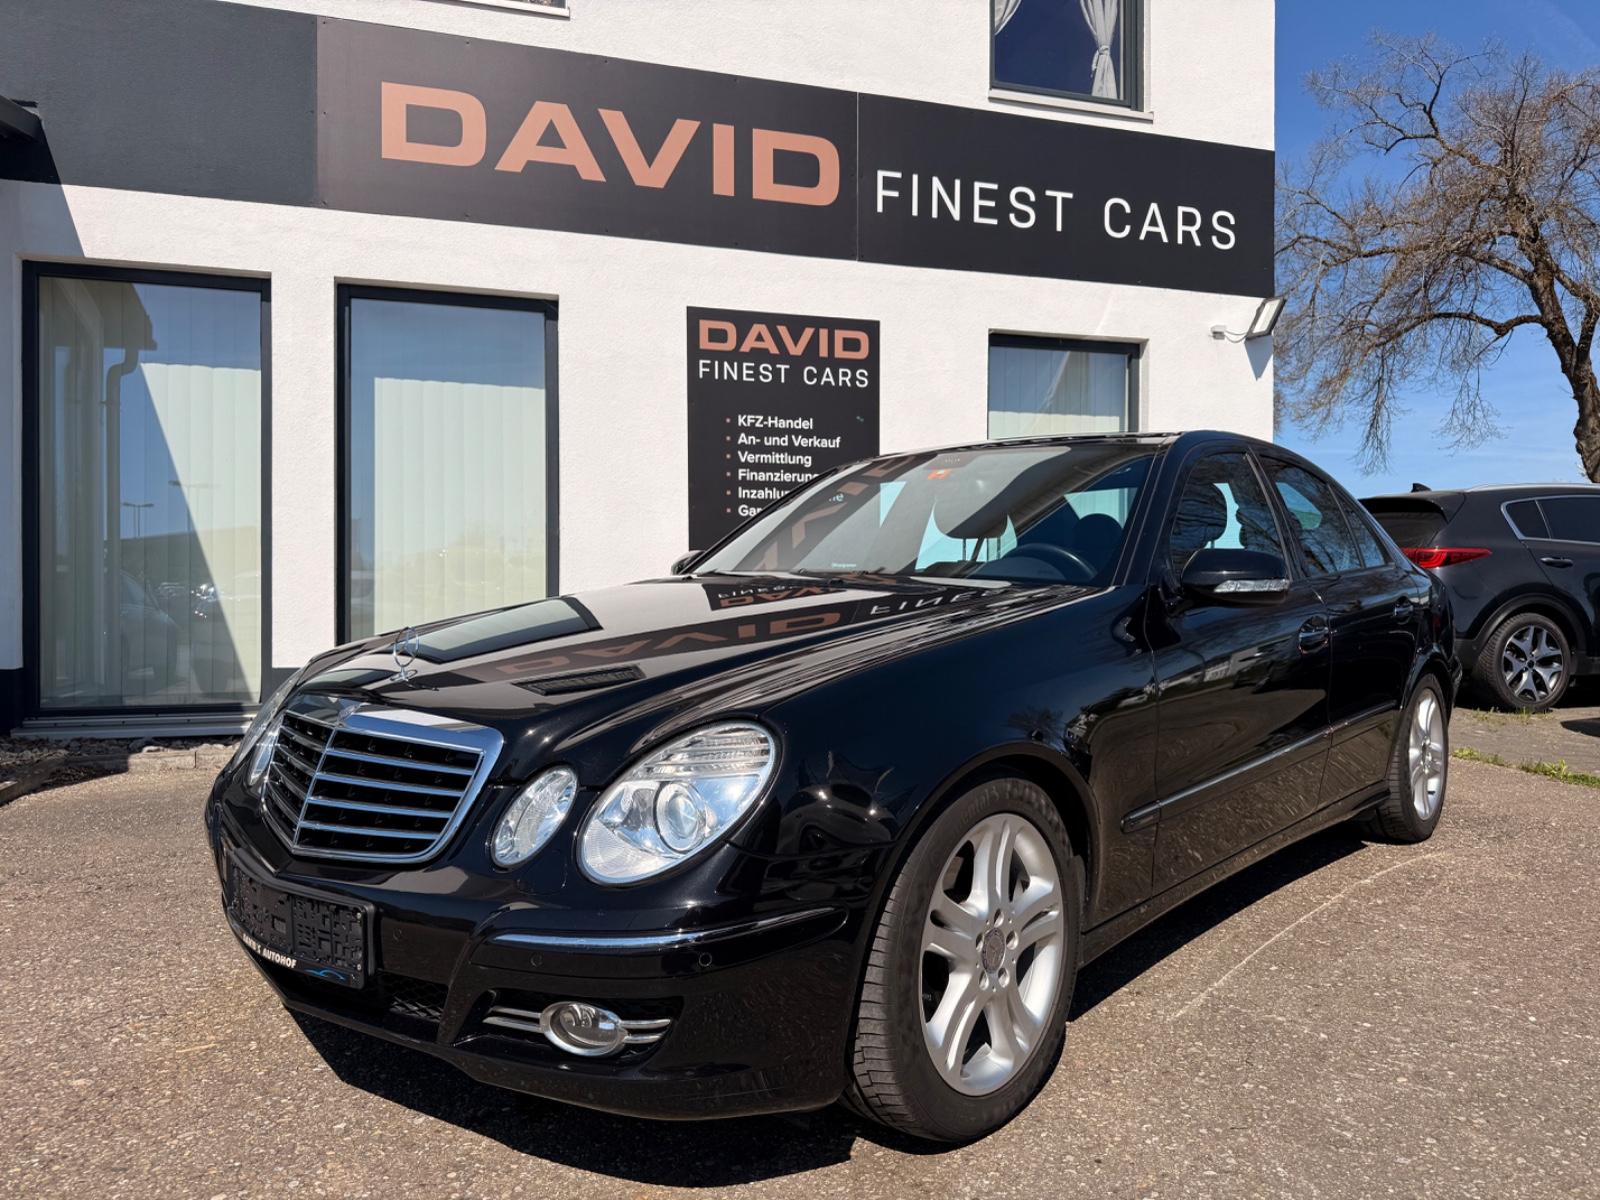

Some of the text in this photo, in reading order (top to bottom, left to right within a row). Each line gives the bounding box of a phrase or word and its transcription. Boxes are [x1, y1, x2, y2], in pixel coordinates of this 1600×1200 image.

[381, 81, 1236, 250] DAVID FINEST CARS
[698, 319, 870, 360] DAVID
[698, 359, 869, 388] FINEST CARS
[737, 414, 814, 430] KFZ-Handel
[737, 432, 842, 448] An- und Verkauf
[737, 450, 812, 468] Vermittlung
[737, 468, 820, 483] Finanzierun
